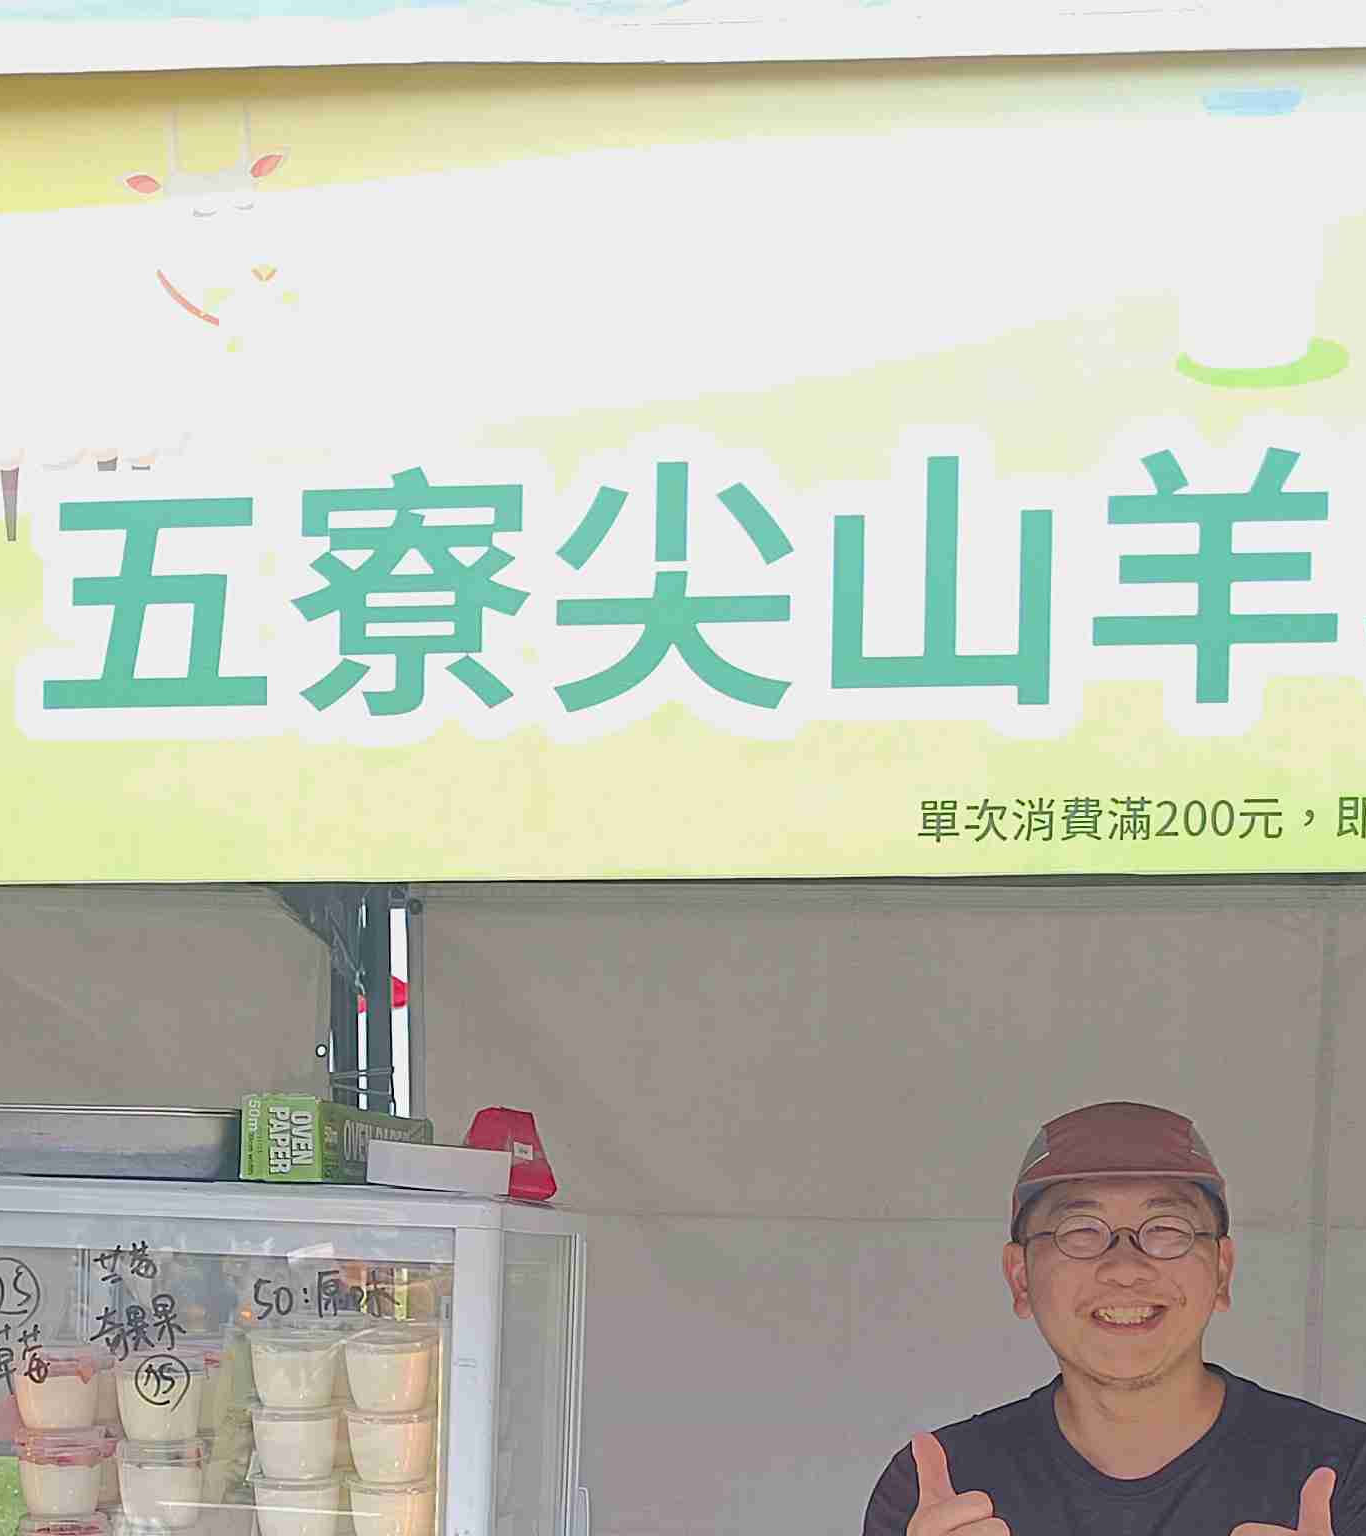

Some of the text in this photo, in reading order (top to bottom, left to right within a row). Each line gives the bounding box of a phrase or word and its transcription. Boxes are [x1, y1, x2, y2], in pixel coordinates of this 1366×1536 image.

[267, 1104, 291, 1175] PAPER
[290, 1110, 314, 1167] OVEN
[89, 1293, 187, 1361] 奇異果
